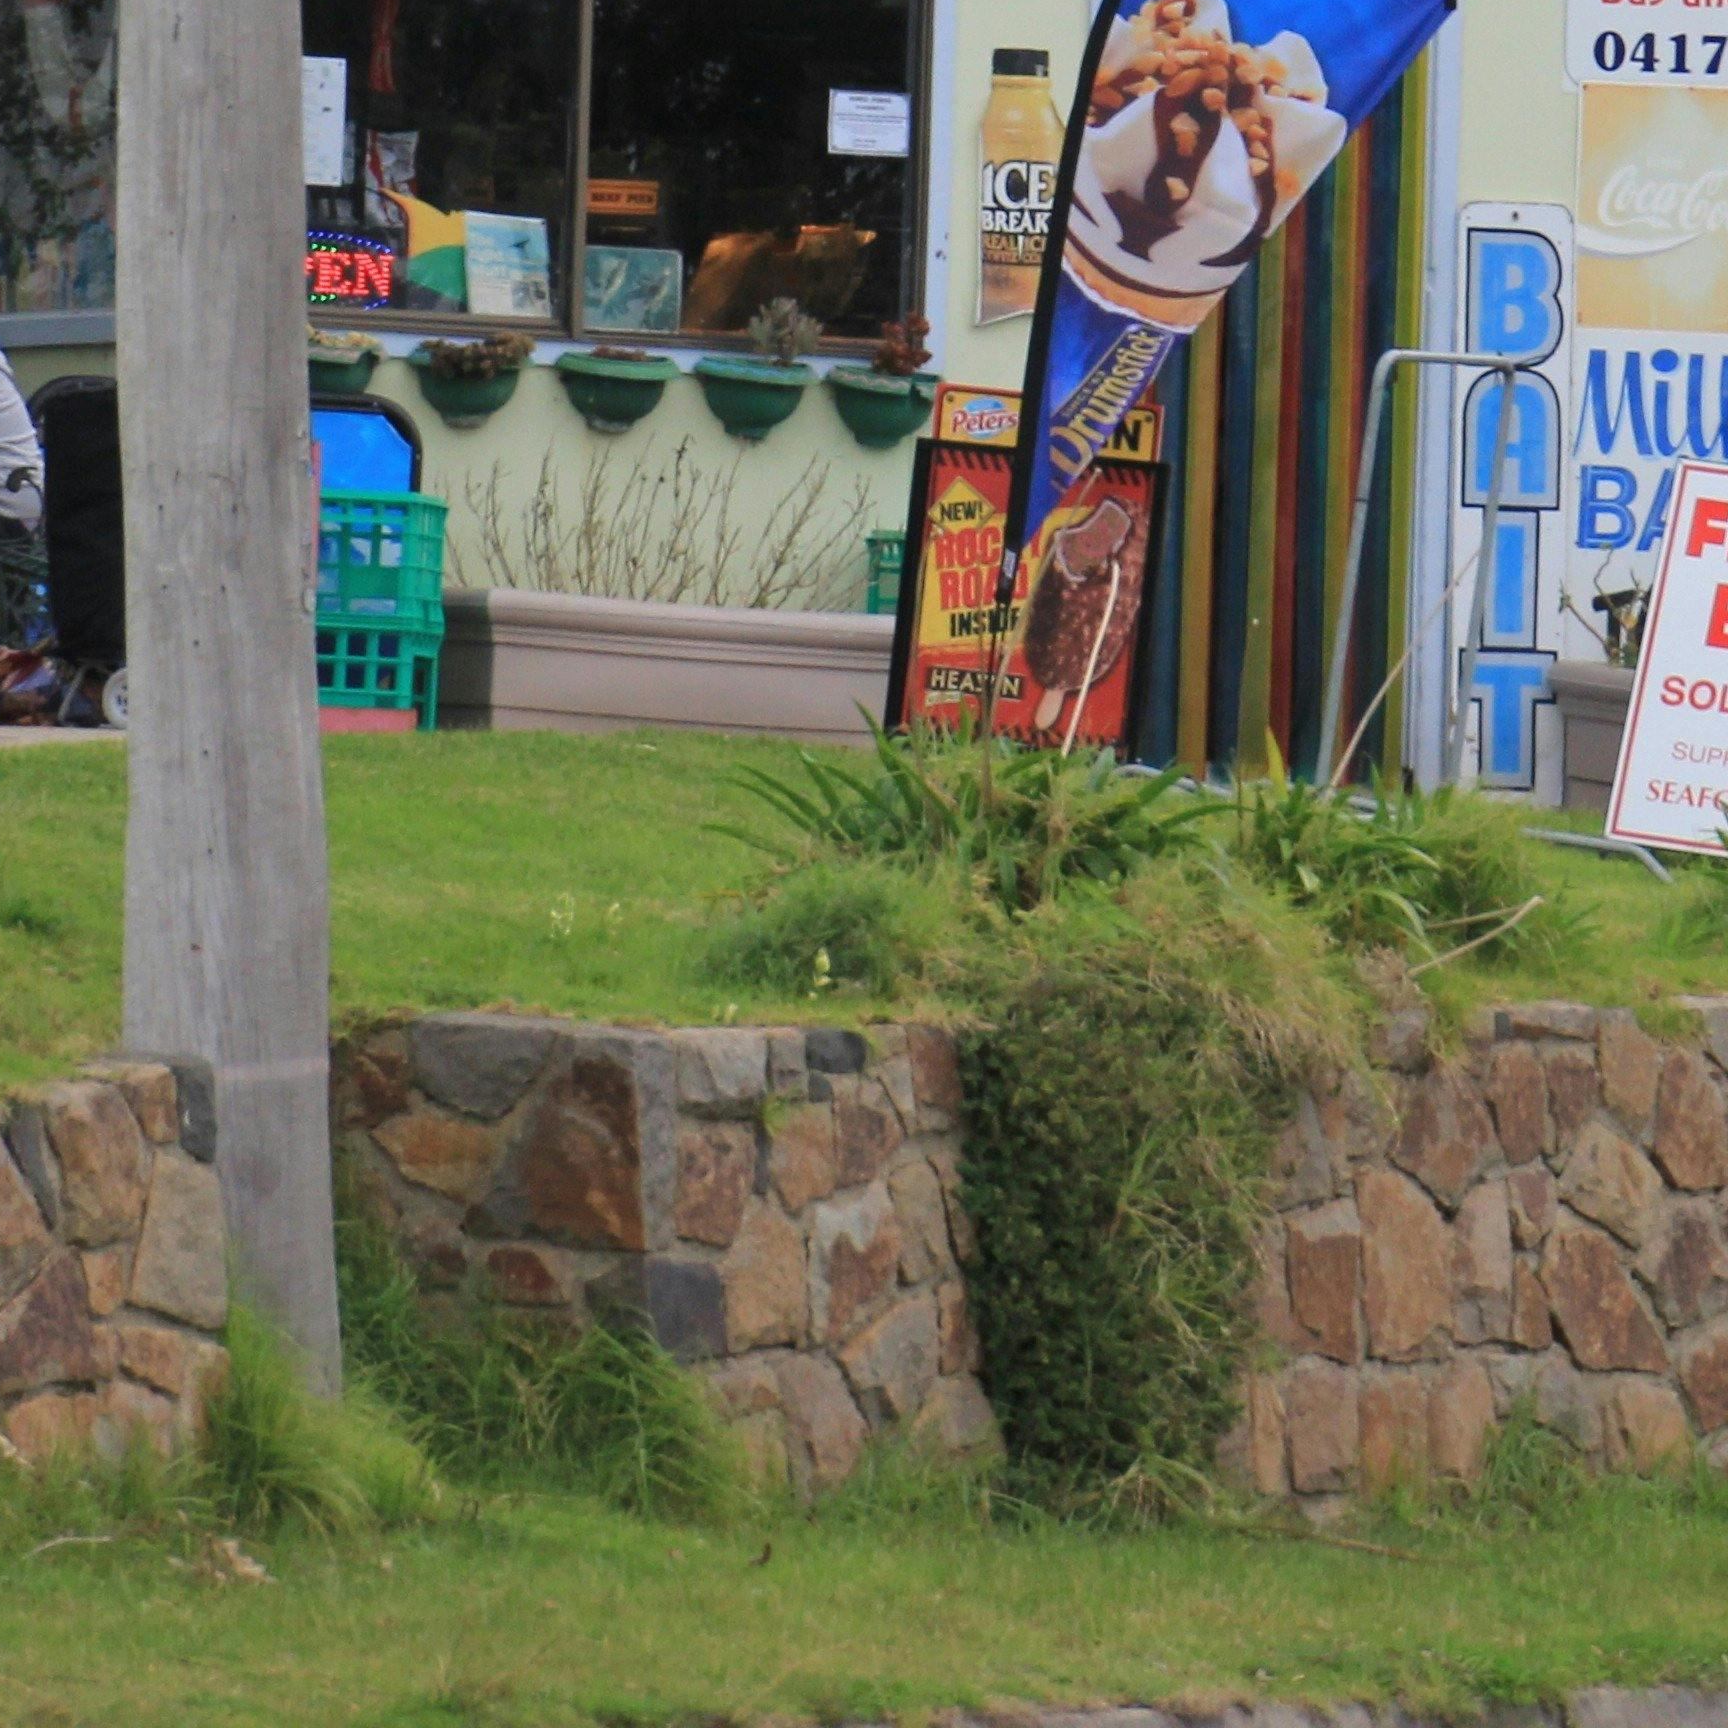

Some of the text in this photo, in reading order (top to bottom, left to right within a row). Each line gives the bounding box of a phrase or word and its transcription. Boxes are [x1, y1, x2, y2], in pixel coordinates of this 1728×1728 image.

[1592, 30, 1728, 75] 0417
[981, 161, 1055, 210] ICE
[981, 209, 1052, 234] BREAK
[951, 409, 1020, 434] Peters
[1049, 330, 1164, 482] Drumstick
[940, 500, 984, 522] NEW!
[1460, 227, 1564, 789] BAIT
[930, 668, 1021, 697] HEAN
